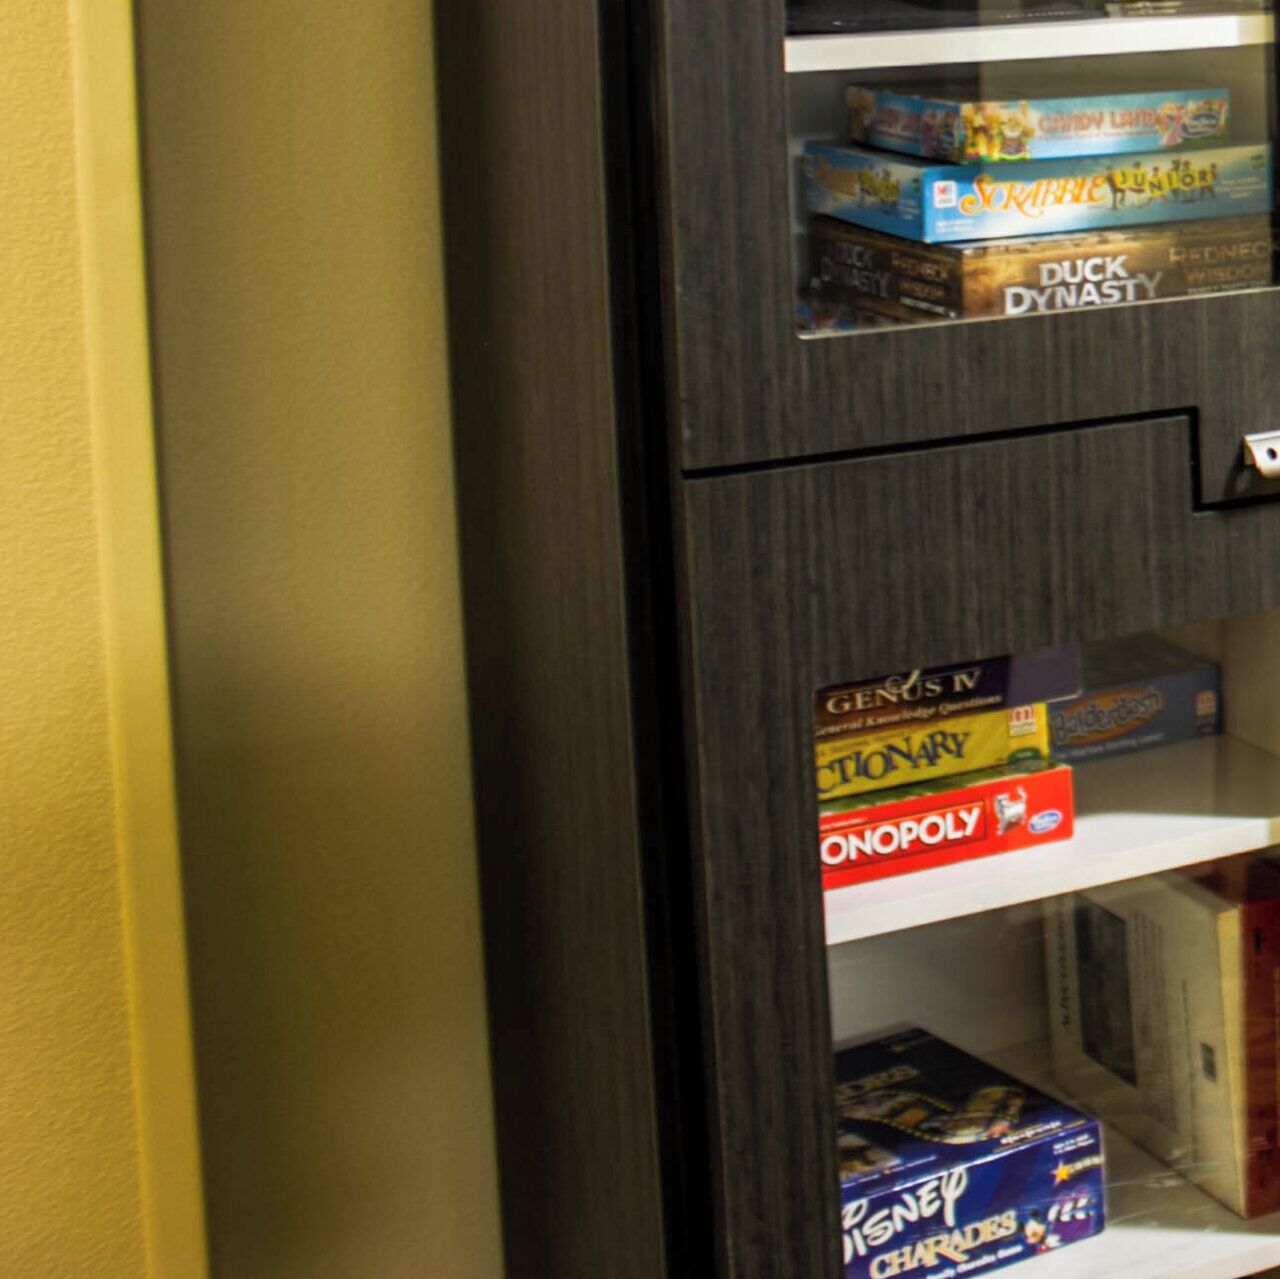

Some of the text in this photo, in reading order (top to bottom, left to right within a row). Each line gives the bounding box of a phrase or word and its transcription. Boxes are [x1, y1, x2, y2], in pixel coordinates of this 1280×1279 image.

[1037, 110, 1103, 133] CANDY
[958, 173, 1109, 219] SCRABBLE
[1116, 165, 1213, 197] JUNIOR
[1003, 270, 1164, 316] DYNASTY
[1039, 254, 1129, 288] DUCK
[825, 669, 983, 715] GENUS IV
[815, 729, 970, 795] CTIONARY
[820, 806, 981, 866] ONOPOLY
[869, 1210, 1019, 1279] CHARADES
